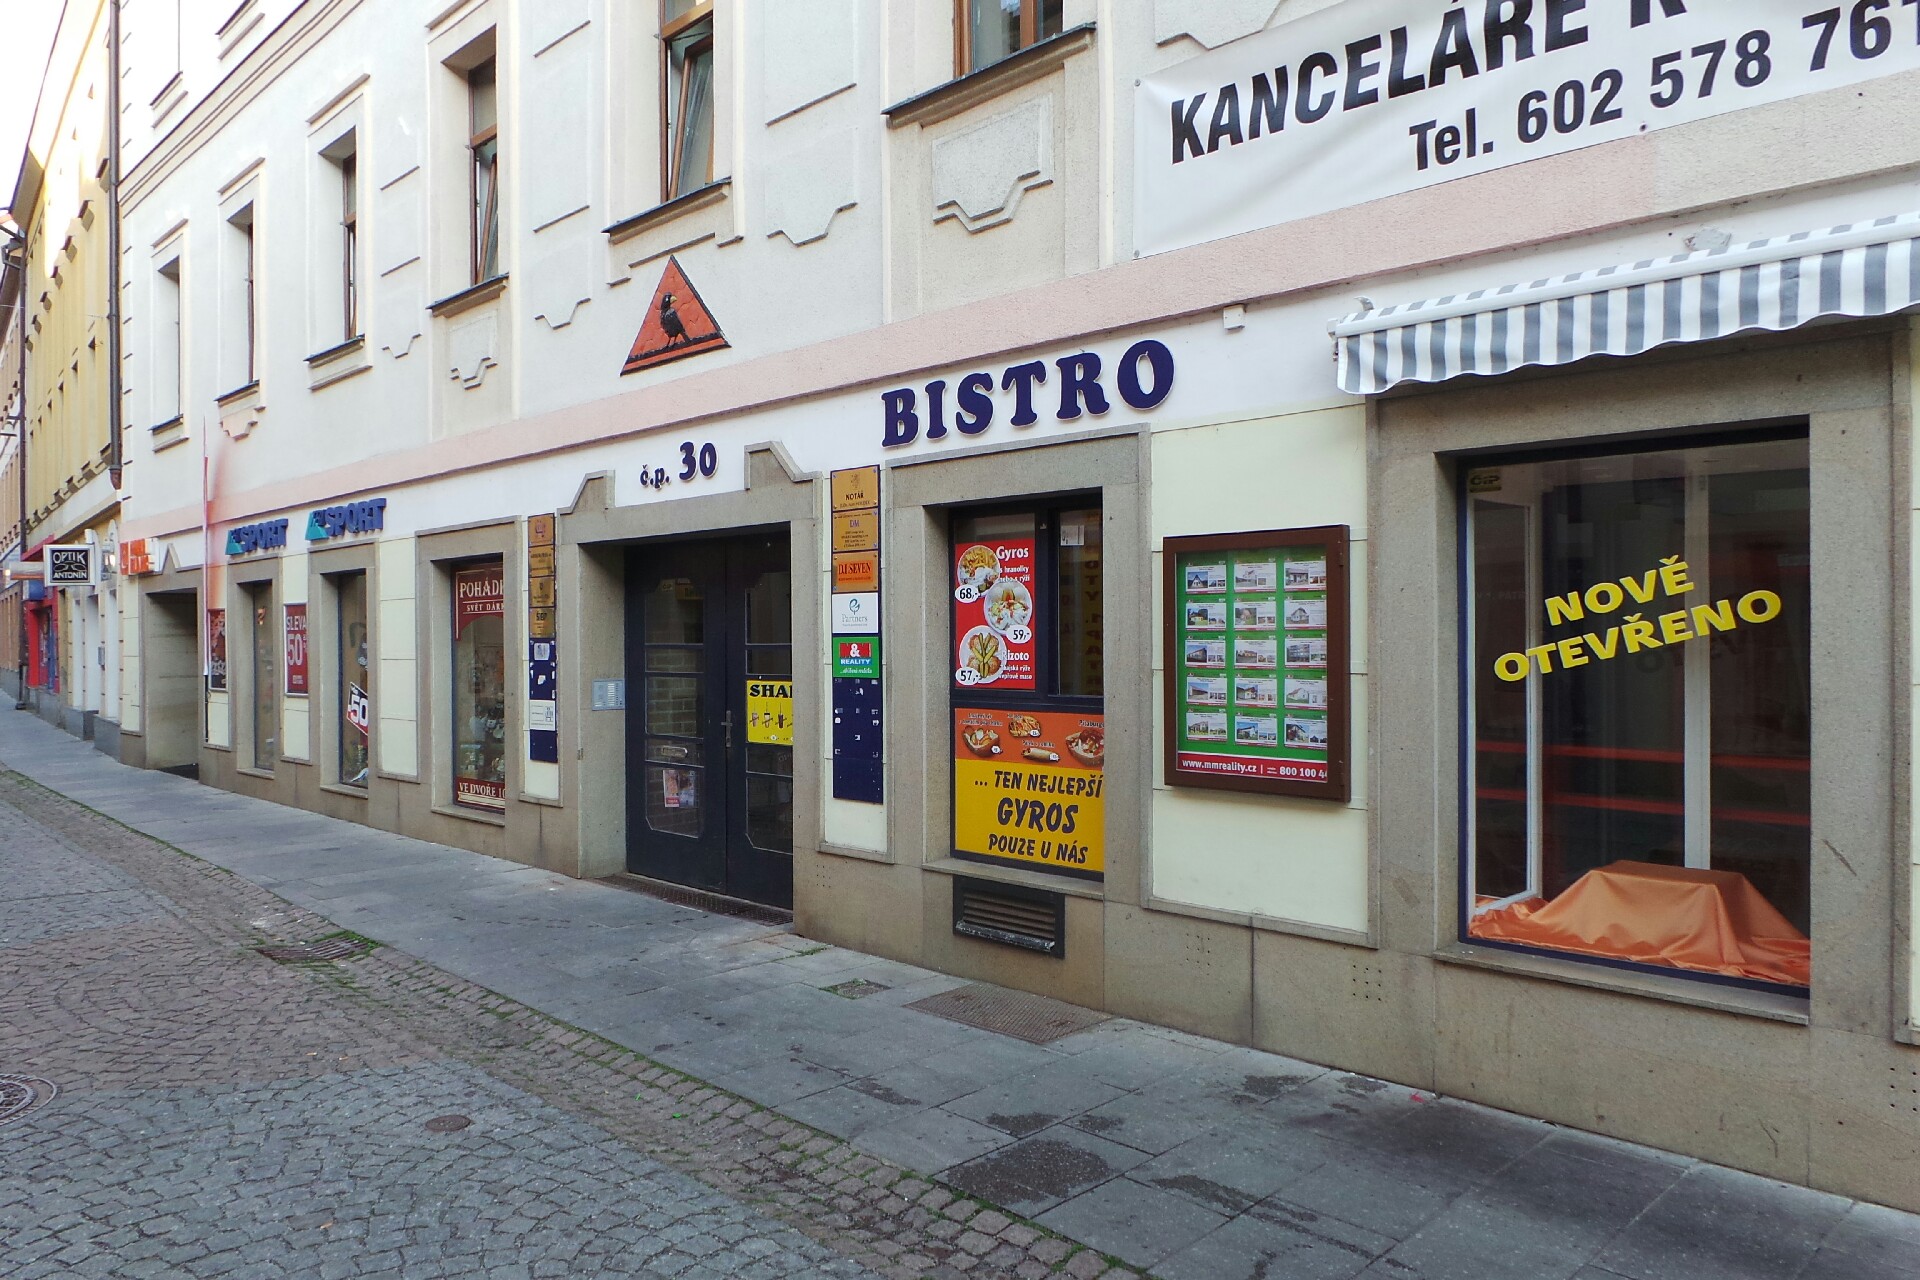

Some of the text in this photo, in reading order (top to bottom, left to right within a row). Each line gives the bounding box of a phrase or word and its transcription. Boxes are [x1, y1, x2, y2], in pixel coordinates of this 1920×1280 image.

[1409, 0, 1920, 171] Tel. 602 578 76
[881, 339, 1175, 448] BISTRO
[640, 441, 717, 489] č.p. 30
[325, 498, 386, 537] SPORT
[239, 518, 288, 552] SPORT
[52, 551, 86, 564] OPTIK
[996, 545, 1029, 561] Gyros
[848, 562, 871, 575] SEVEN
[960, 588, 978, 601] 68,-
[1545, 555, 1695, 626] NOVĚ
[287, 615, 307, 630] SLEVA
[1013, 630, 1030, 641] 59,-
[1494, 590, 1781, 682] OTEVŘENO
[1002, 650, 1029, 661] Rizoto
[960, 670, 979, 682] 57,-
[1182, 759, 1257, 773] www.mmreality.cz
[1279, 766, 1297, 776] 800
[1299, 767, 1316, 778] 100
[459, 782, 469, 792] VE
[470, 784, 496, 796] DVOŘE
[995, 770, 1022, 790] TEN
[1027, 774, 1103, 798] NEJLEPŠÍ
[997, 797, 1079, 833] GYROS
[989, 833, 1088, 864] POUZE U NÁS
